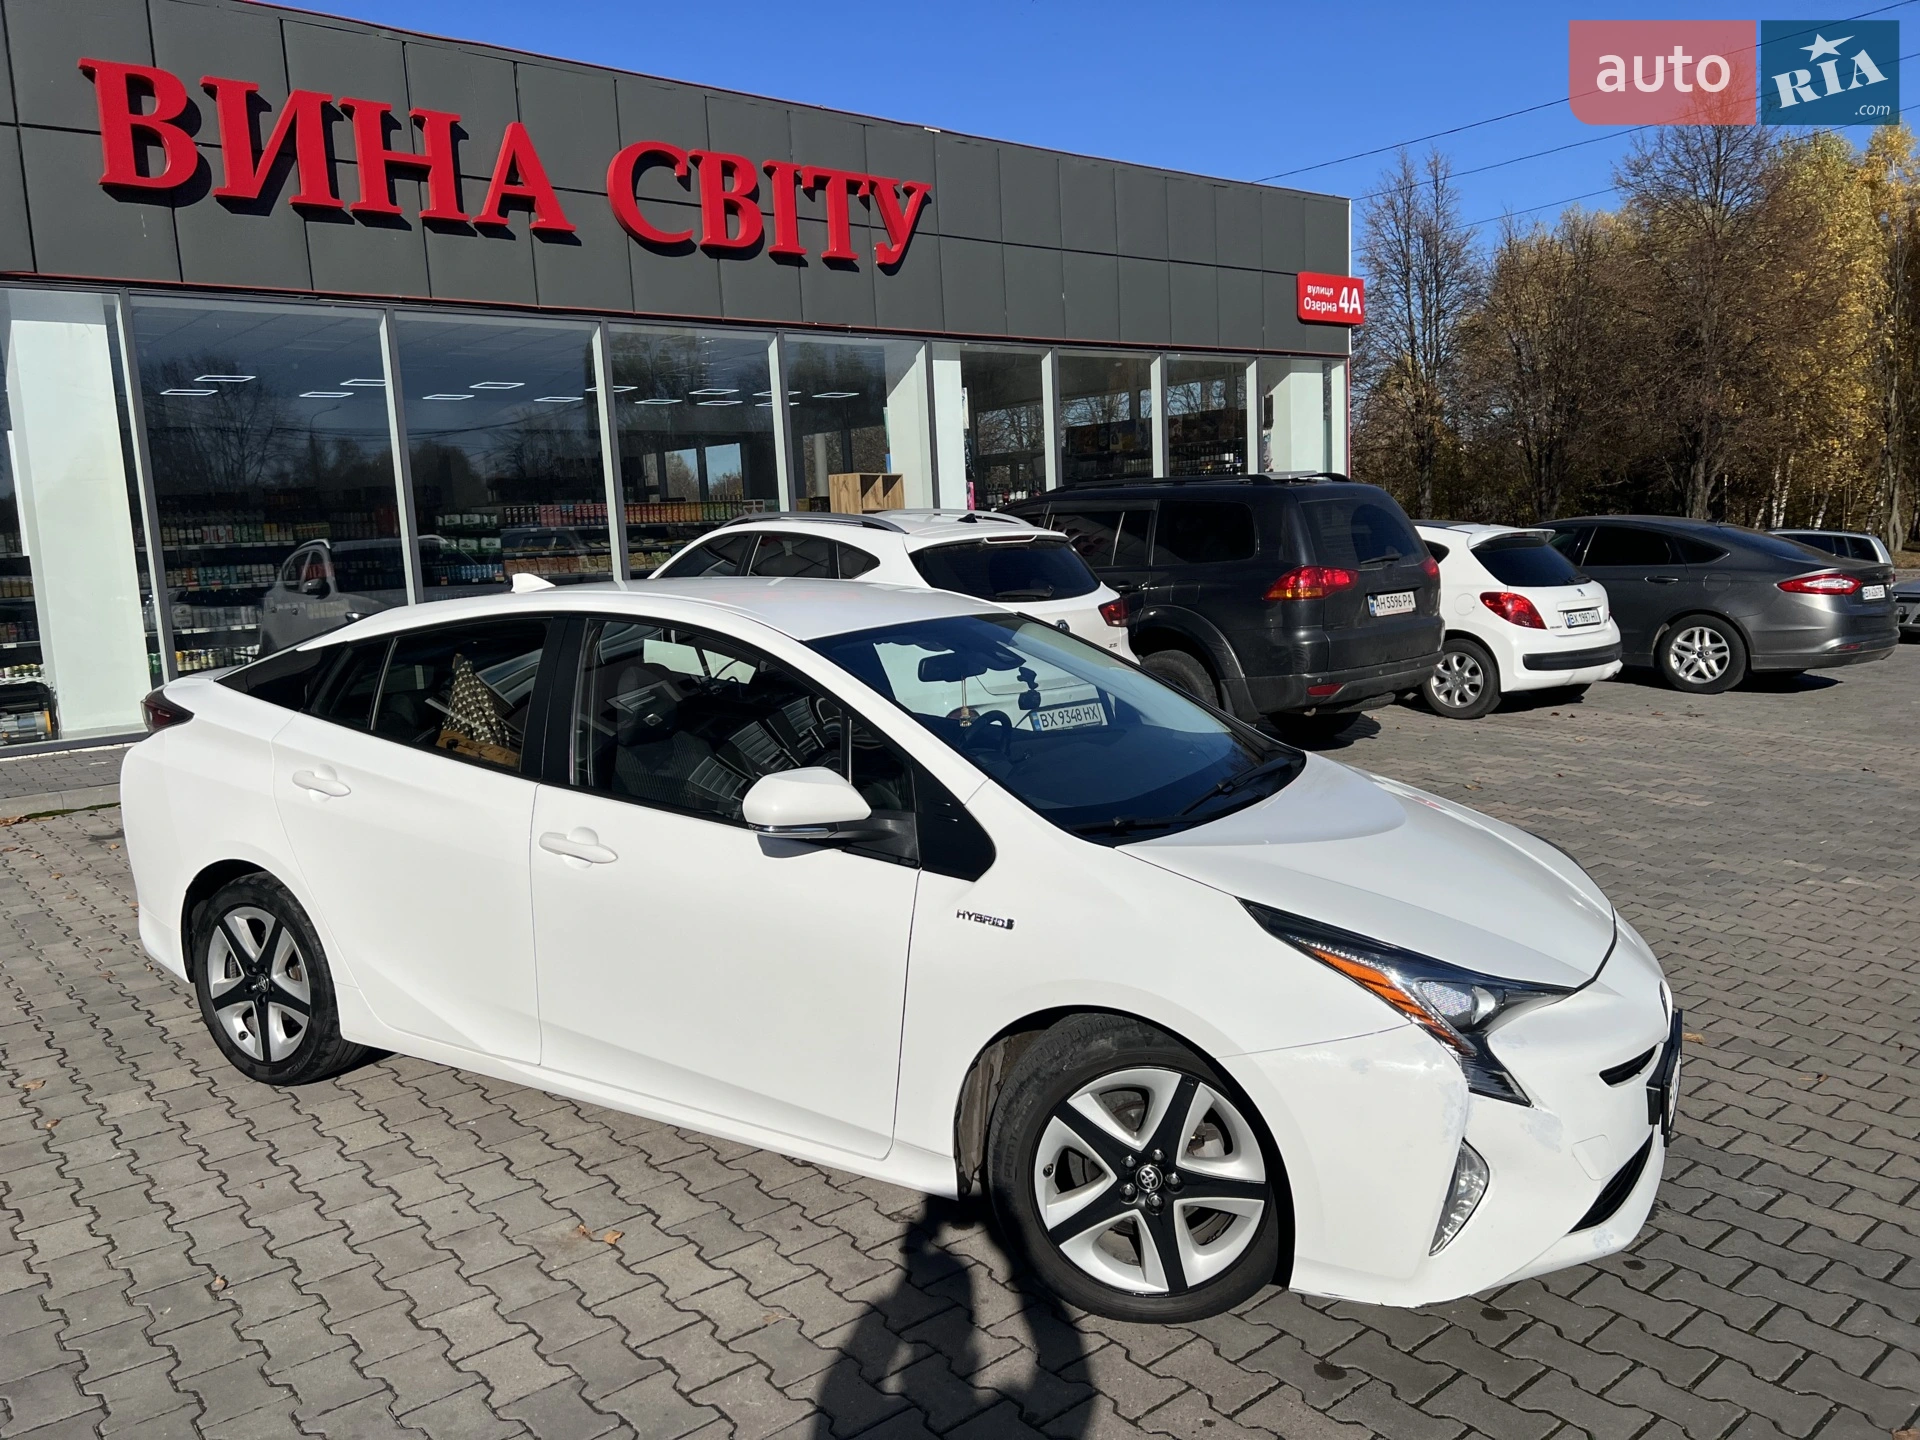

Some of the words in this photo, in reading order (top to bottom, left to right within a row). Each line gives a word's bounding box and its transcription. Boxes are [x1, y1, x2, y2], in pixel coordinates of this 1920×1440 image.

[77, 57, 576, 233] ВИНА
[606, 140, 932, 266] СВІТУ
[1307, 285, 1334, 297] вулиця
[1339, 286, 1362, 315] 4А
[1303, 297, 1337, 314] Озерна
[1040, 712, 1058, 728] BX
[1058, 708, 1083, 725] 9348
[1082, 705, 1099, 721] HX
[956, 909, 1006, 928] HYBRID
